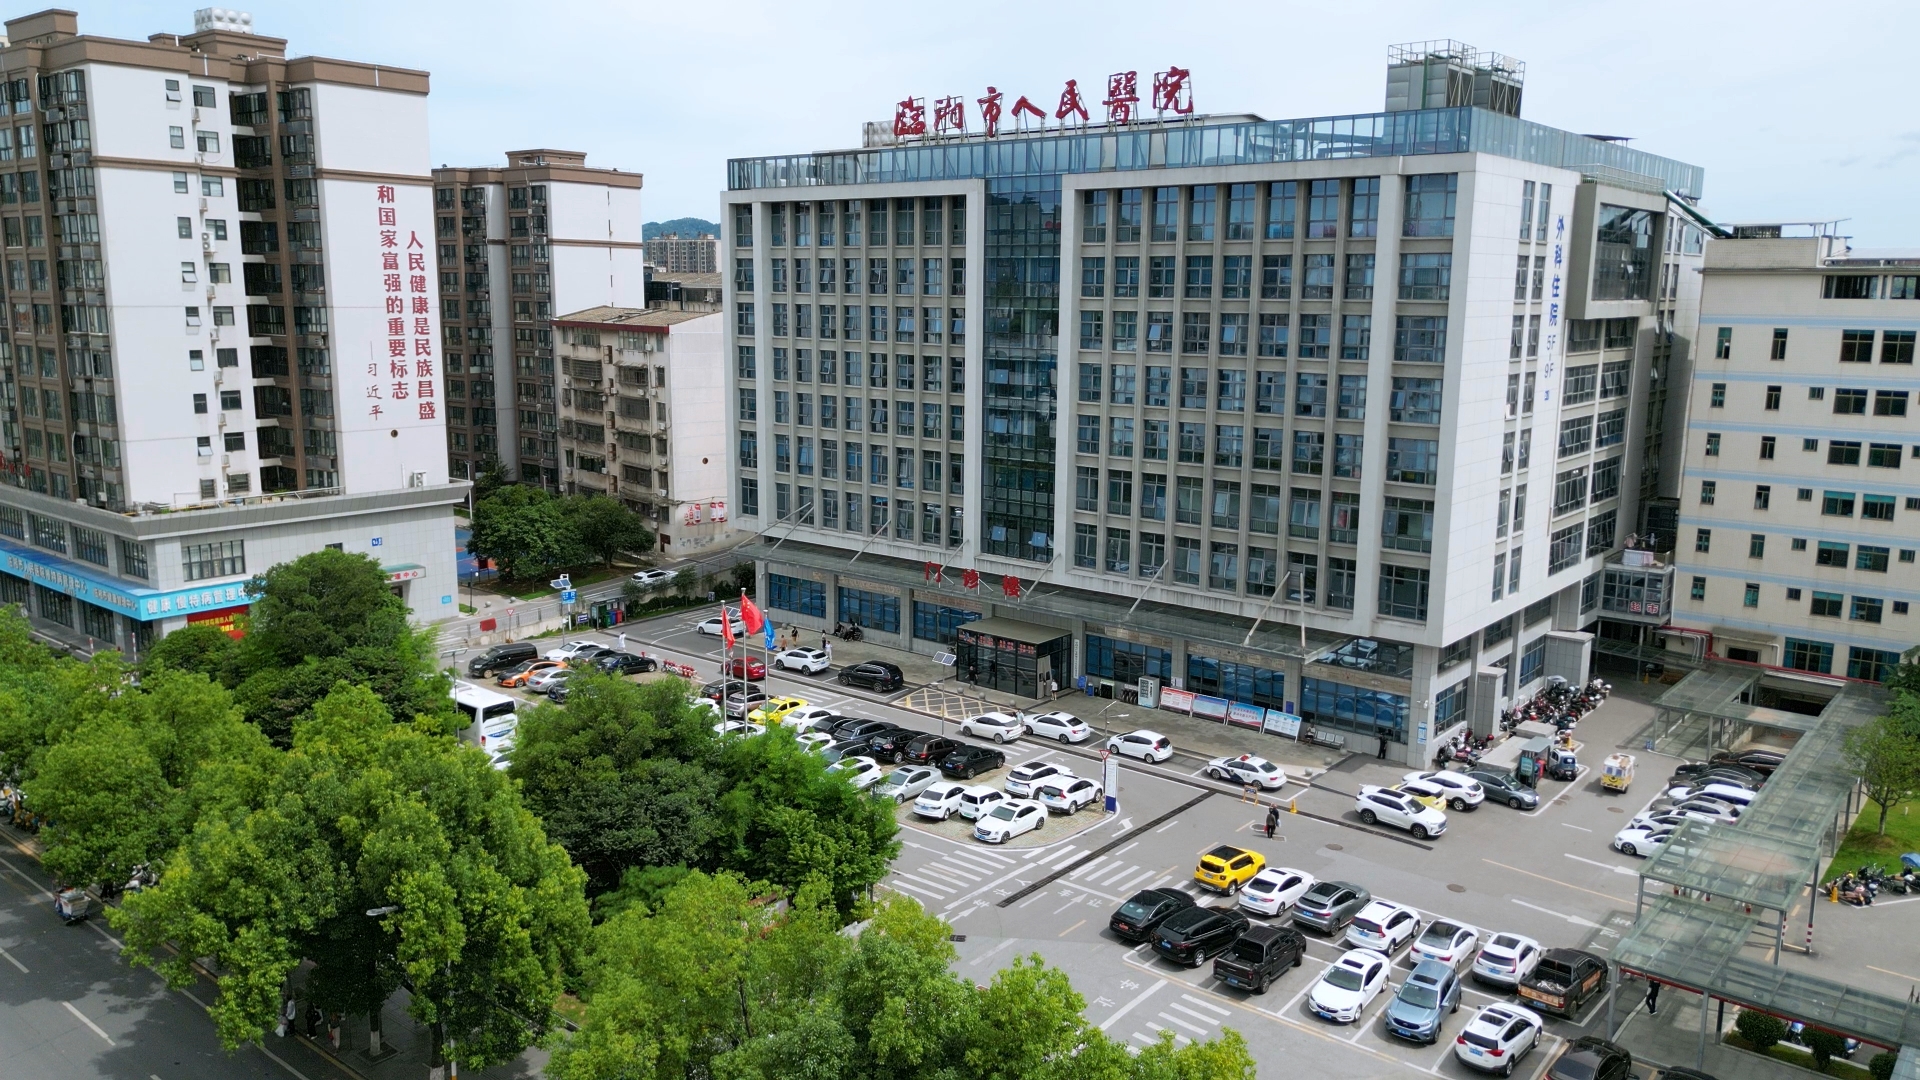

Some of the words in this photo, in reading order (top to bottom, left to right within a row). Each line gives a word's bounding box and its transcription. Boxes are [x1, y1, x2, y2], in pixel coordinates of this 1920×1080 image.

[377, 184, 409, 400] 和国家富强的重要标志
[406, 230, 436, 420] 人民健康是民族昌盛
[146, 597, 172, 615] 健康
[175, 583, 260, 610] 慢特病管理中
[1630, 601, 1659, 614] 超市
